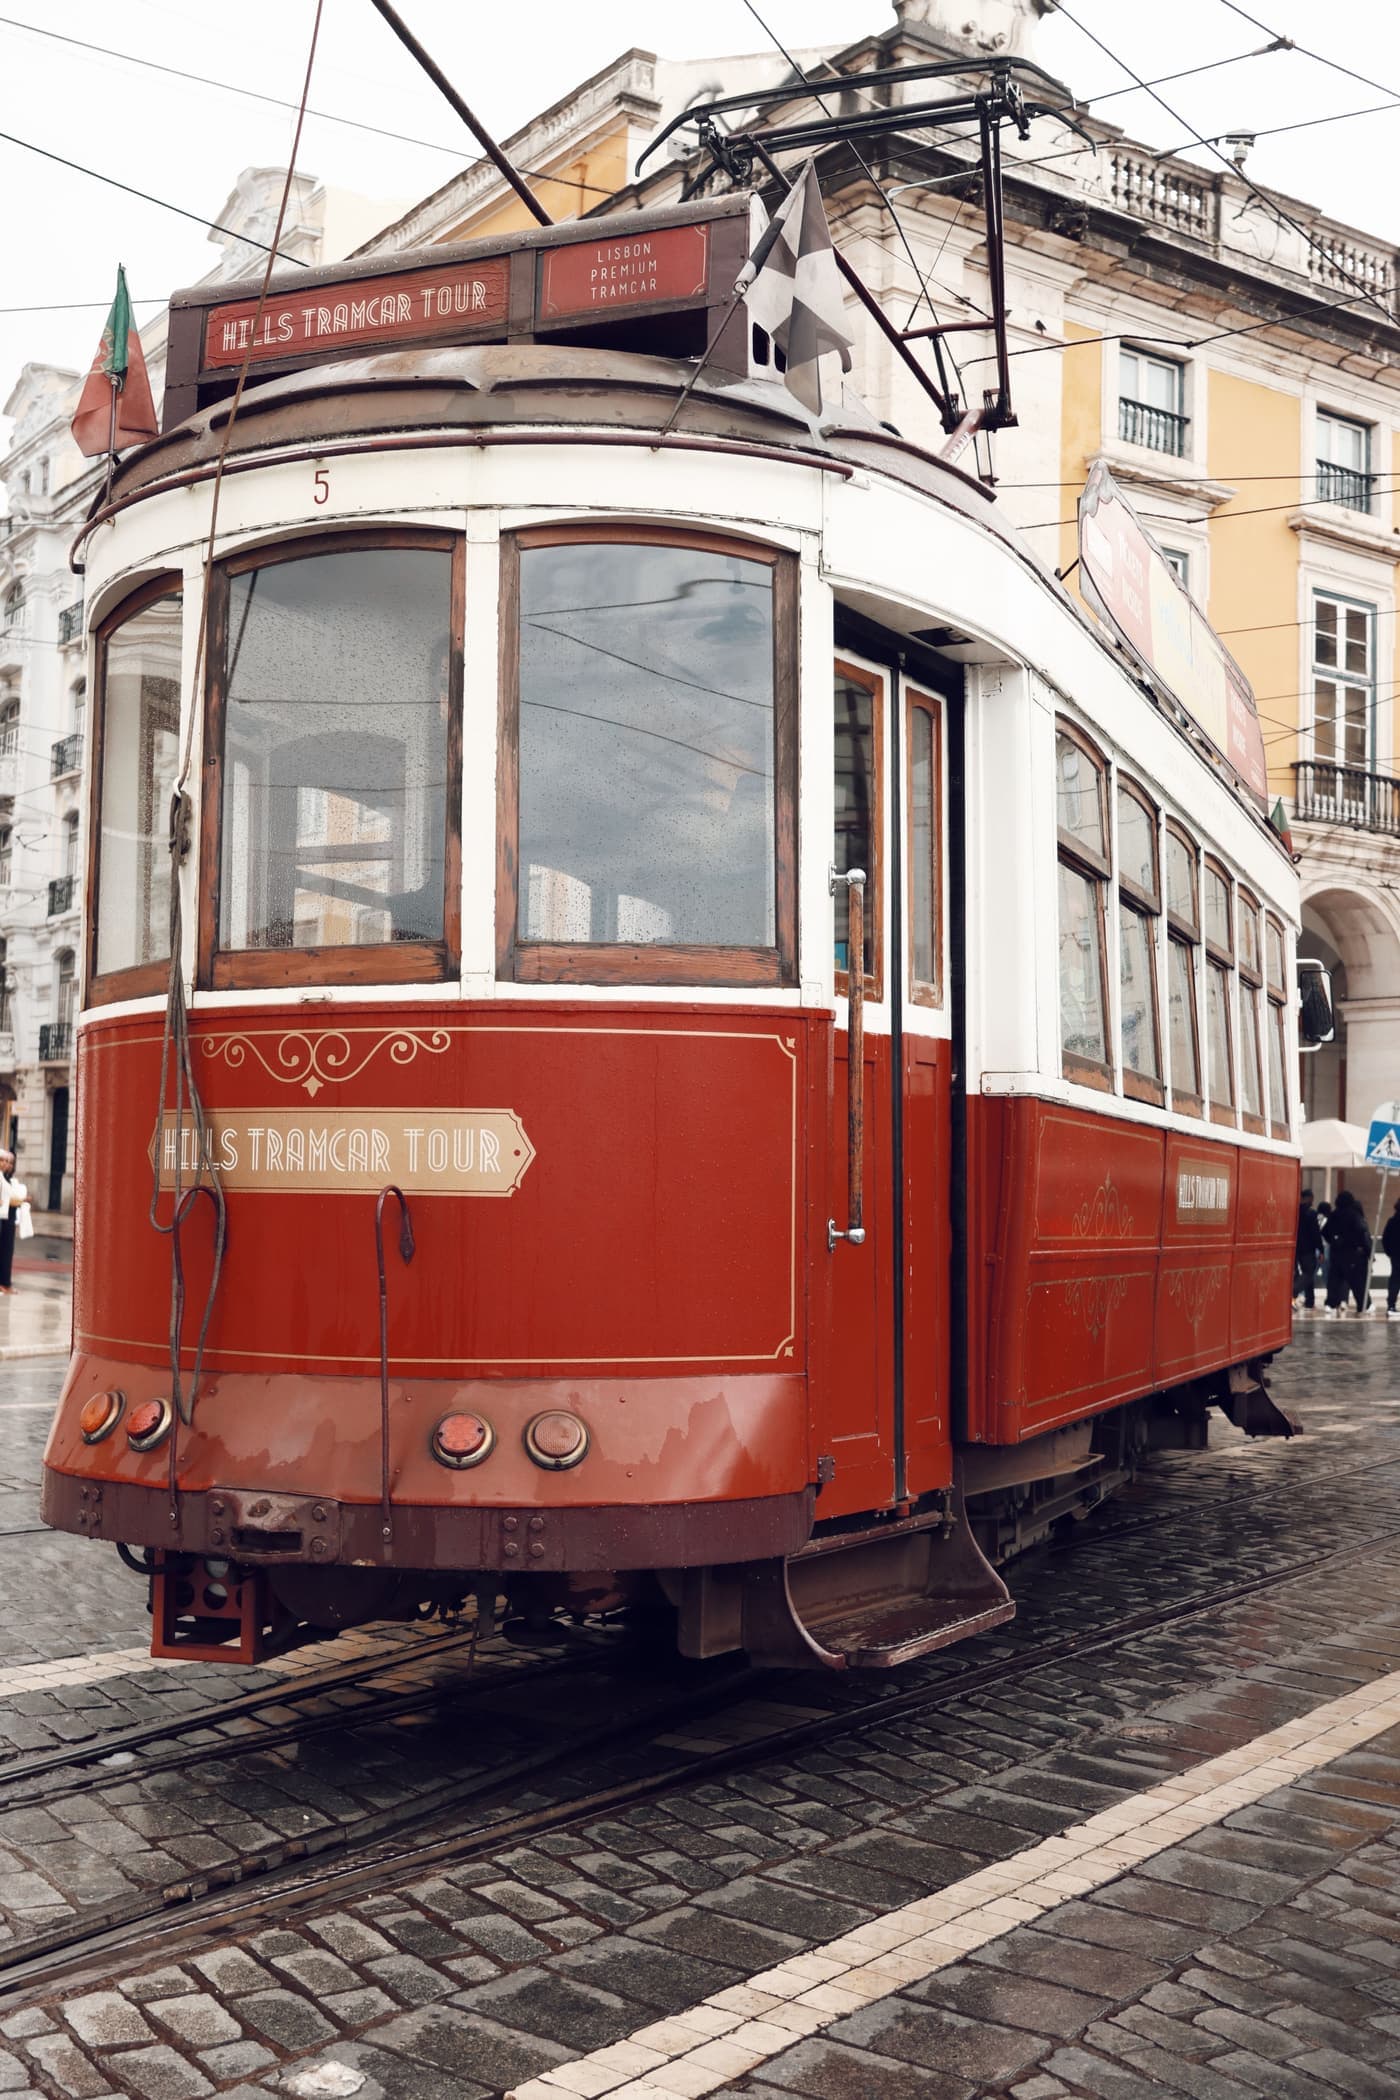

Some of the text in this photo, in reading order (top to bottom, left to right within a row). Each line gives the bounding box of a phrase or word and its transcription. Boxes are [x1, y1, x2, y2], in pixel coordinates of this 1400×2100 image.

[597, 242, 651, 263] LISBON
[591, 260, 657, 282] PREMIUM
[590, 278, 657, 300] TRAMCAR
[222, 281, 487, 352] HILLS TRAMCAR TOUR
[313, 469, 330, 505] 5
[164, 1128, 501, 1172] HILLS TRAMCAR TOUR
